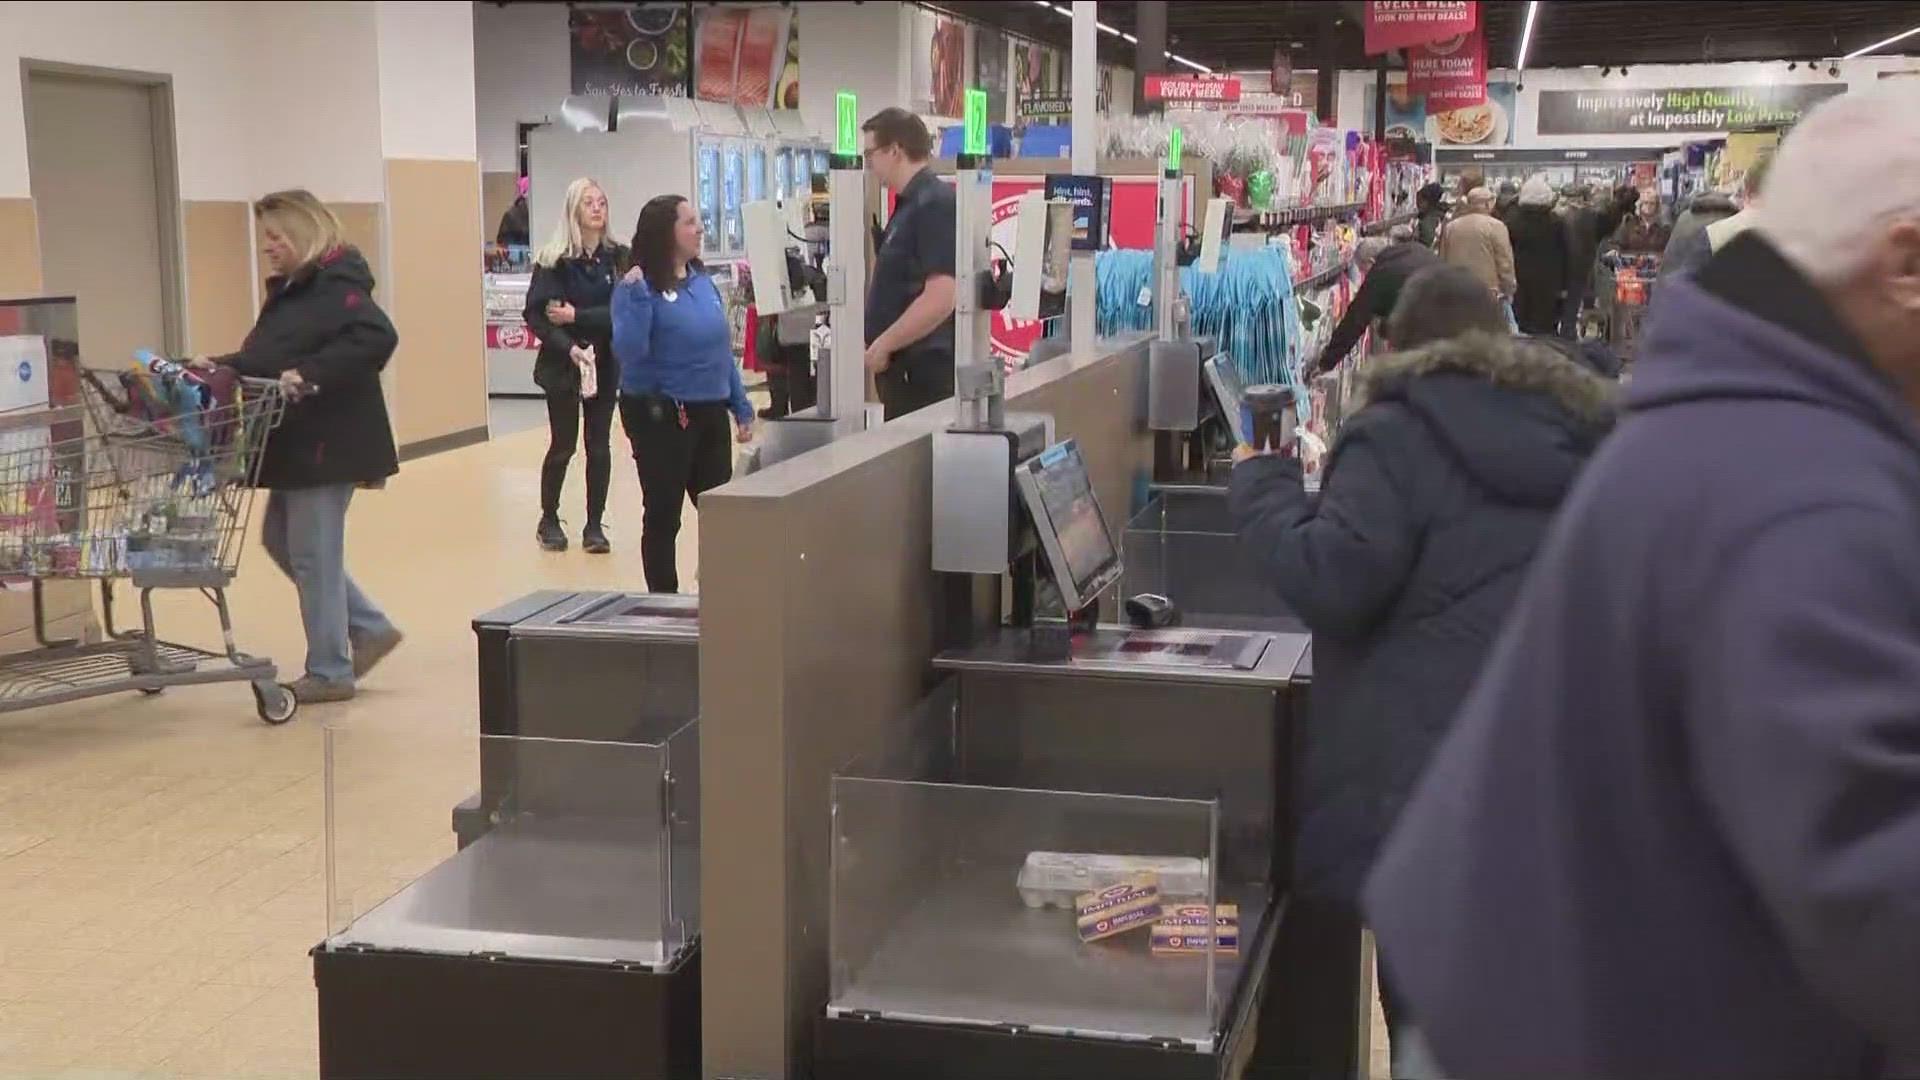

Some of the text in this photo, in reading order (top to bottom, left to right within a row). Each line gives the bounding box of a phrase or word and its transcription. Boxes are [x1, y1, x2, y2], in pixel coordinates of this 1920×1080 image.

[1375, 11, 1467, 22] LOOK FOR NEW DEALS!
[1441, 57, 1474, 68] TODAY
[610, 83, 630, 96] Yes
[632, 82, 646, 96] to
[1160, 87, 1222, 98] EVERY WEEK
[1023, 101, 1066, 114] FLAVORED
[1577, 90, 1754, 112] Impressively High Quality
[1629, 112, 1644, 126] at
[1647, 108, 1724, 129] Impossibly
[1727, 108, 1756, 123] Low
